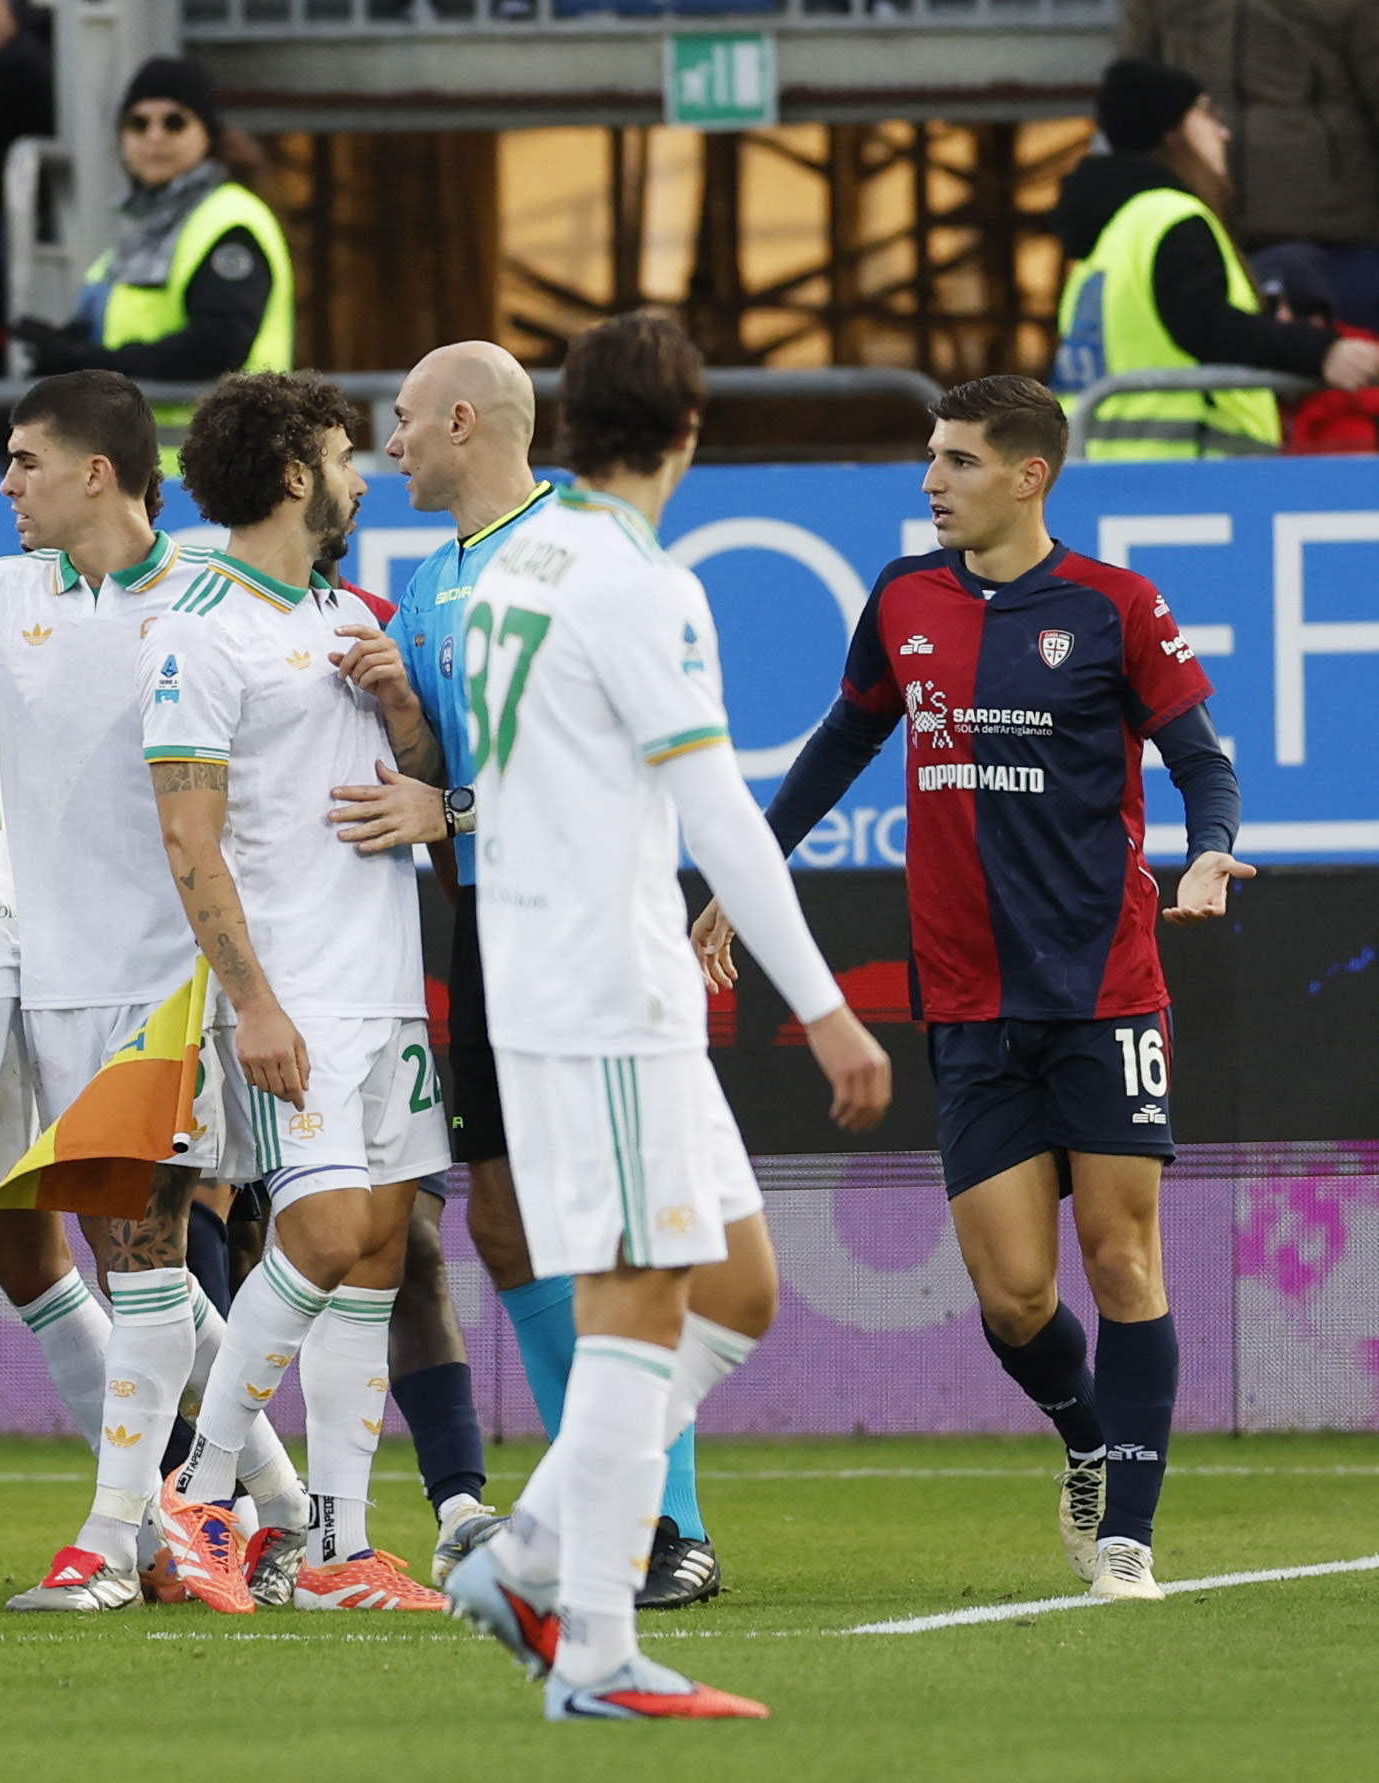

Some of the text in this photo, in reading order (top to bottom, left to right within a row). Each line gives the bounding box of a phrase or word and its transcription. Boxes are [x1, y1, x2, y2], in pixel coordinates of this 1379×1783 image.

[952, 708, 1053, 727] SARDEGNA
[954, 724, 1054, 737] ISOLA dell'Artigianato
[918, 763, 1045, 794] DOPPIO MALTO
[1114, 1028, 1167, 1098] 16
